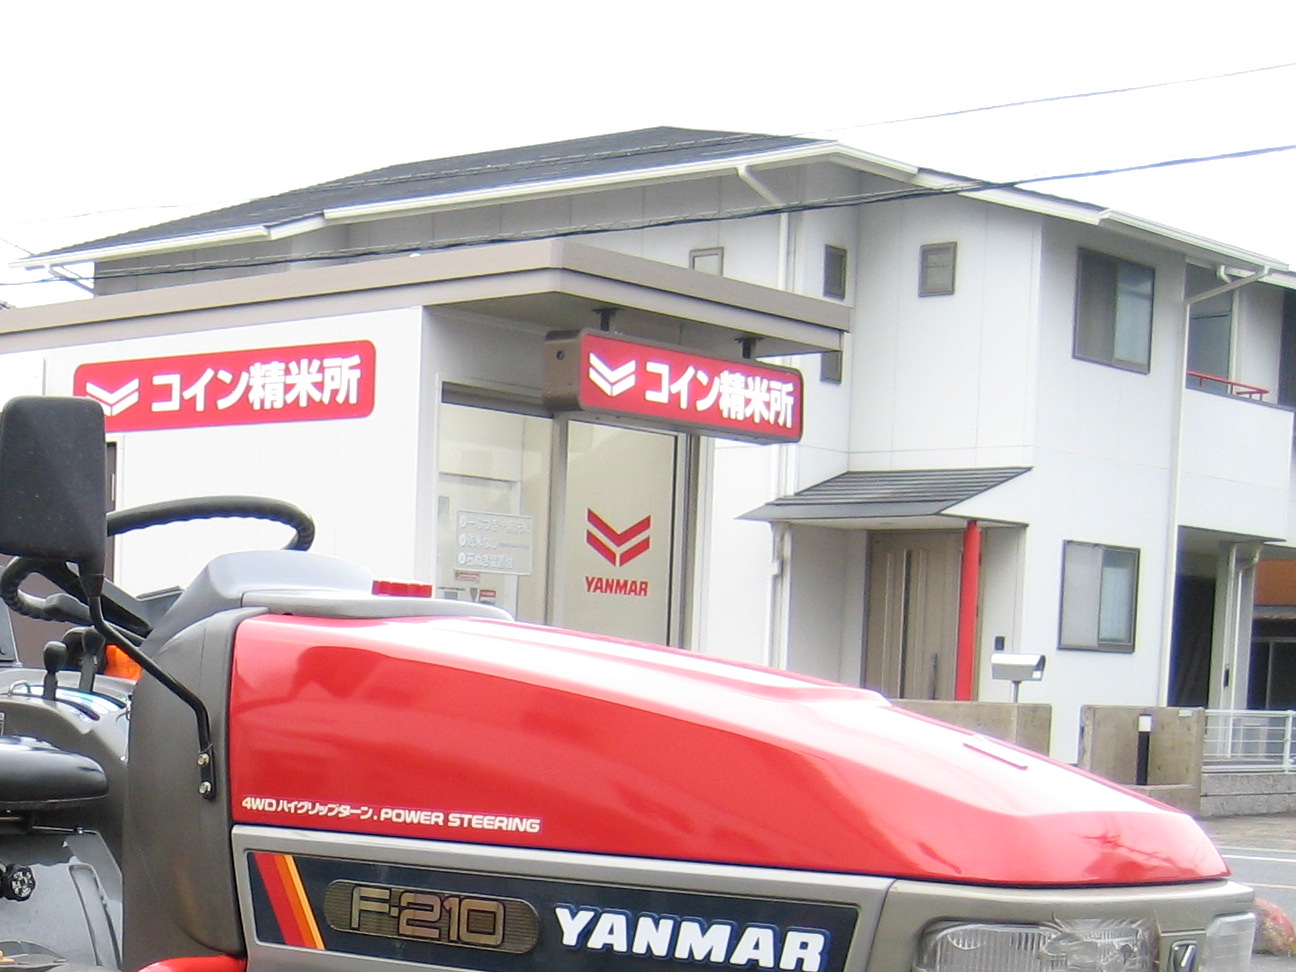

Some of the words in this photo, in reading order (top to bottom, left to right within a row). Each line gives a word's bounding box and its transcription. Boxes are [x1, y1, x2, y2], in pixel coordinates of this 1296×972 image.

[151, 354, 360, 412] コイン精米所
[644, 360, 794, 428] コイン精米所
[585, 575, 648, 596] YANMAR
[380, 807, 444, 826] POWER
[448, 812, 541, 833] STEERING
